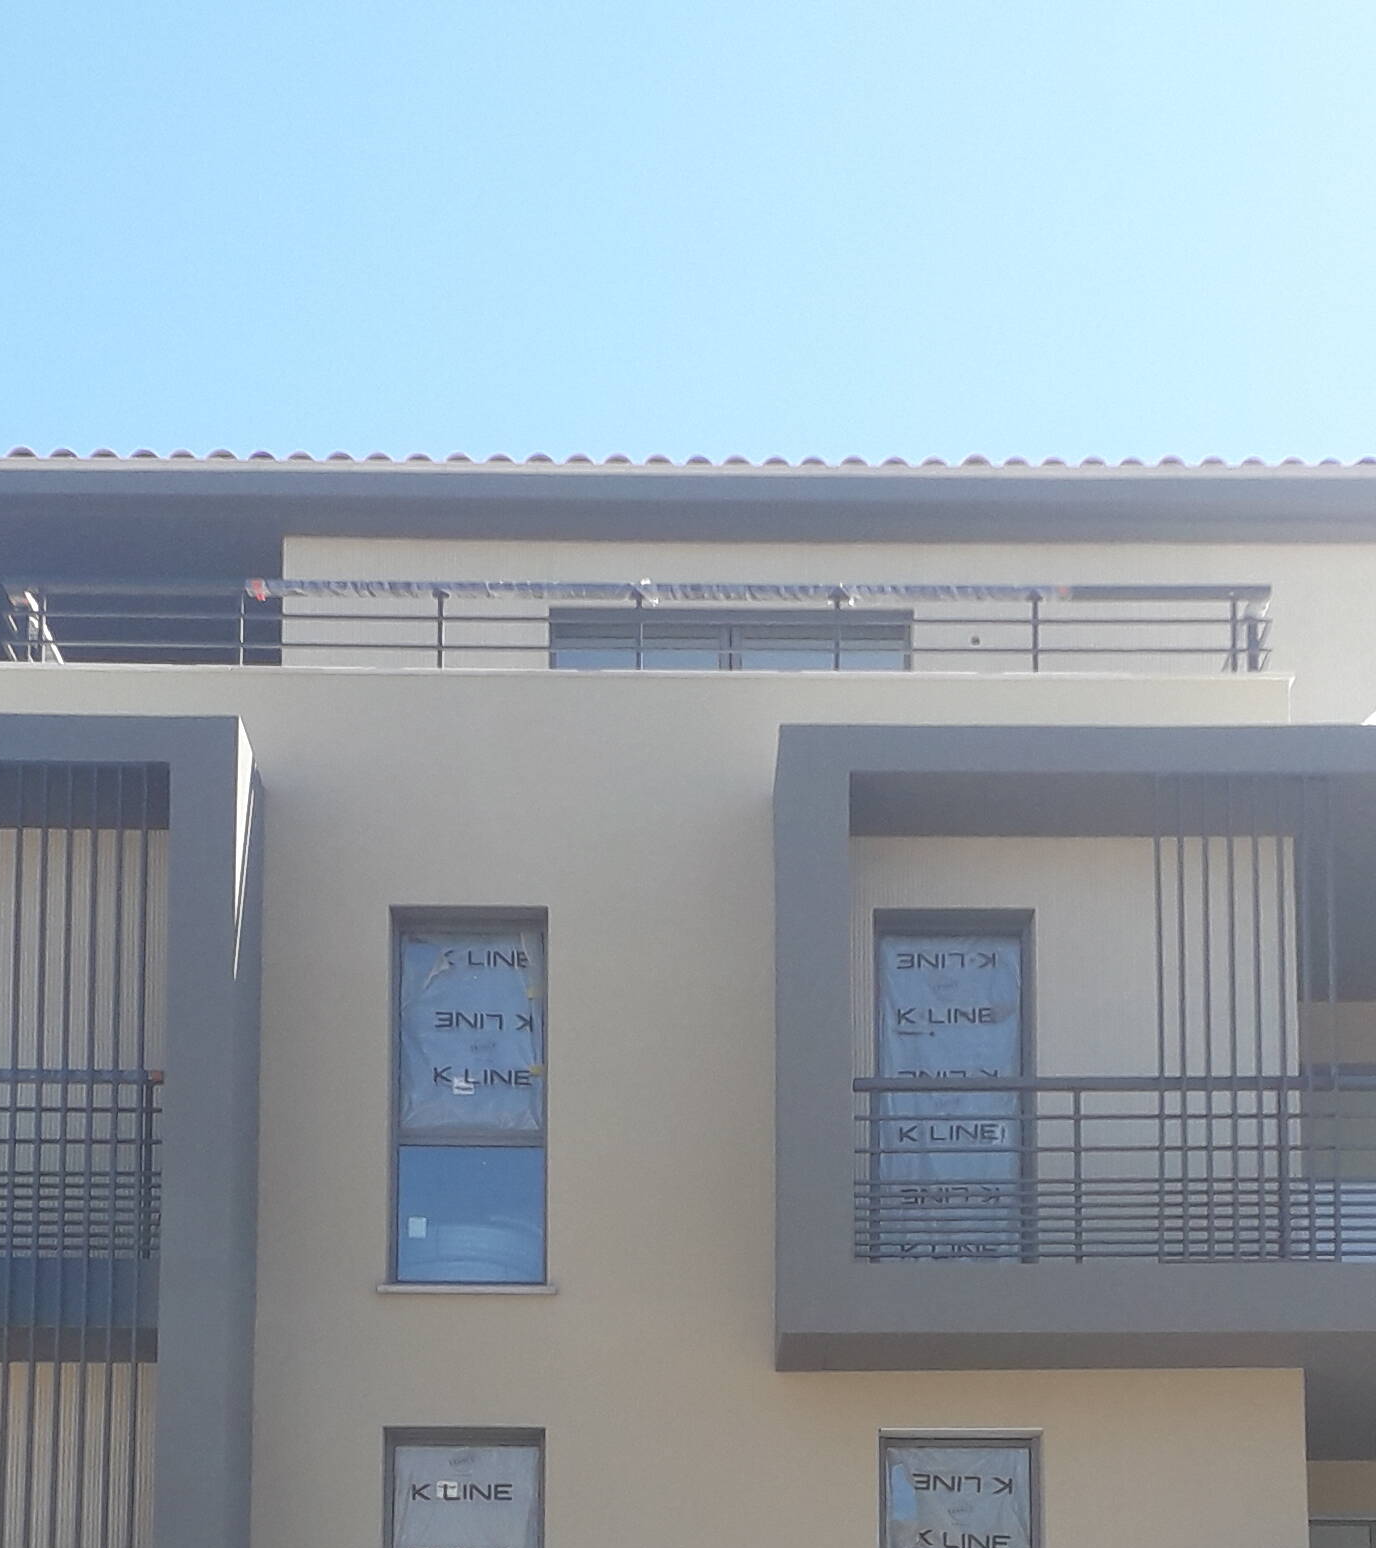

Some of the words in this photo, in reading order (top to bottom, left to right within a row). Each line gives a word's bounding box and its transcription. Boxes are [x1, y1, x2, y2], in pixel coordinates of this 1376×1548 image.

[896, 952, 966, 969] LINE
[979, 952, 997, 969] K
[435, 1011, 504, 1029] LINE
[515, 1014, 533, 1032] K
[897, 1008, 915, 1025] K
[928, 1008, 993, 1024] LINE
[433, 1066, 453, 1084] K
[464, 1068, 532, 1086] LINE
[899, 1125, 917, 1143] K
[930, 1123, 997, 1141] LINE
[411, 1483, 431, 1501] K
[442, 1483, 513, 1501] LINE
[912, 1473, 981, 1493] LINE
[992, 1476, 1013, 1495] K
